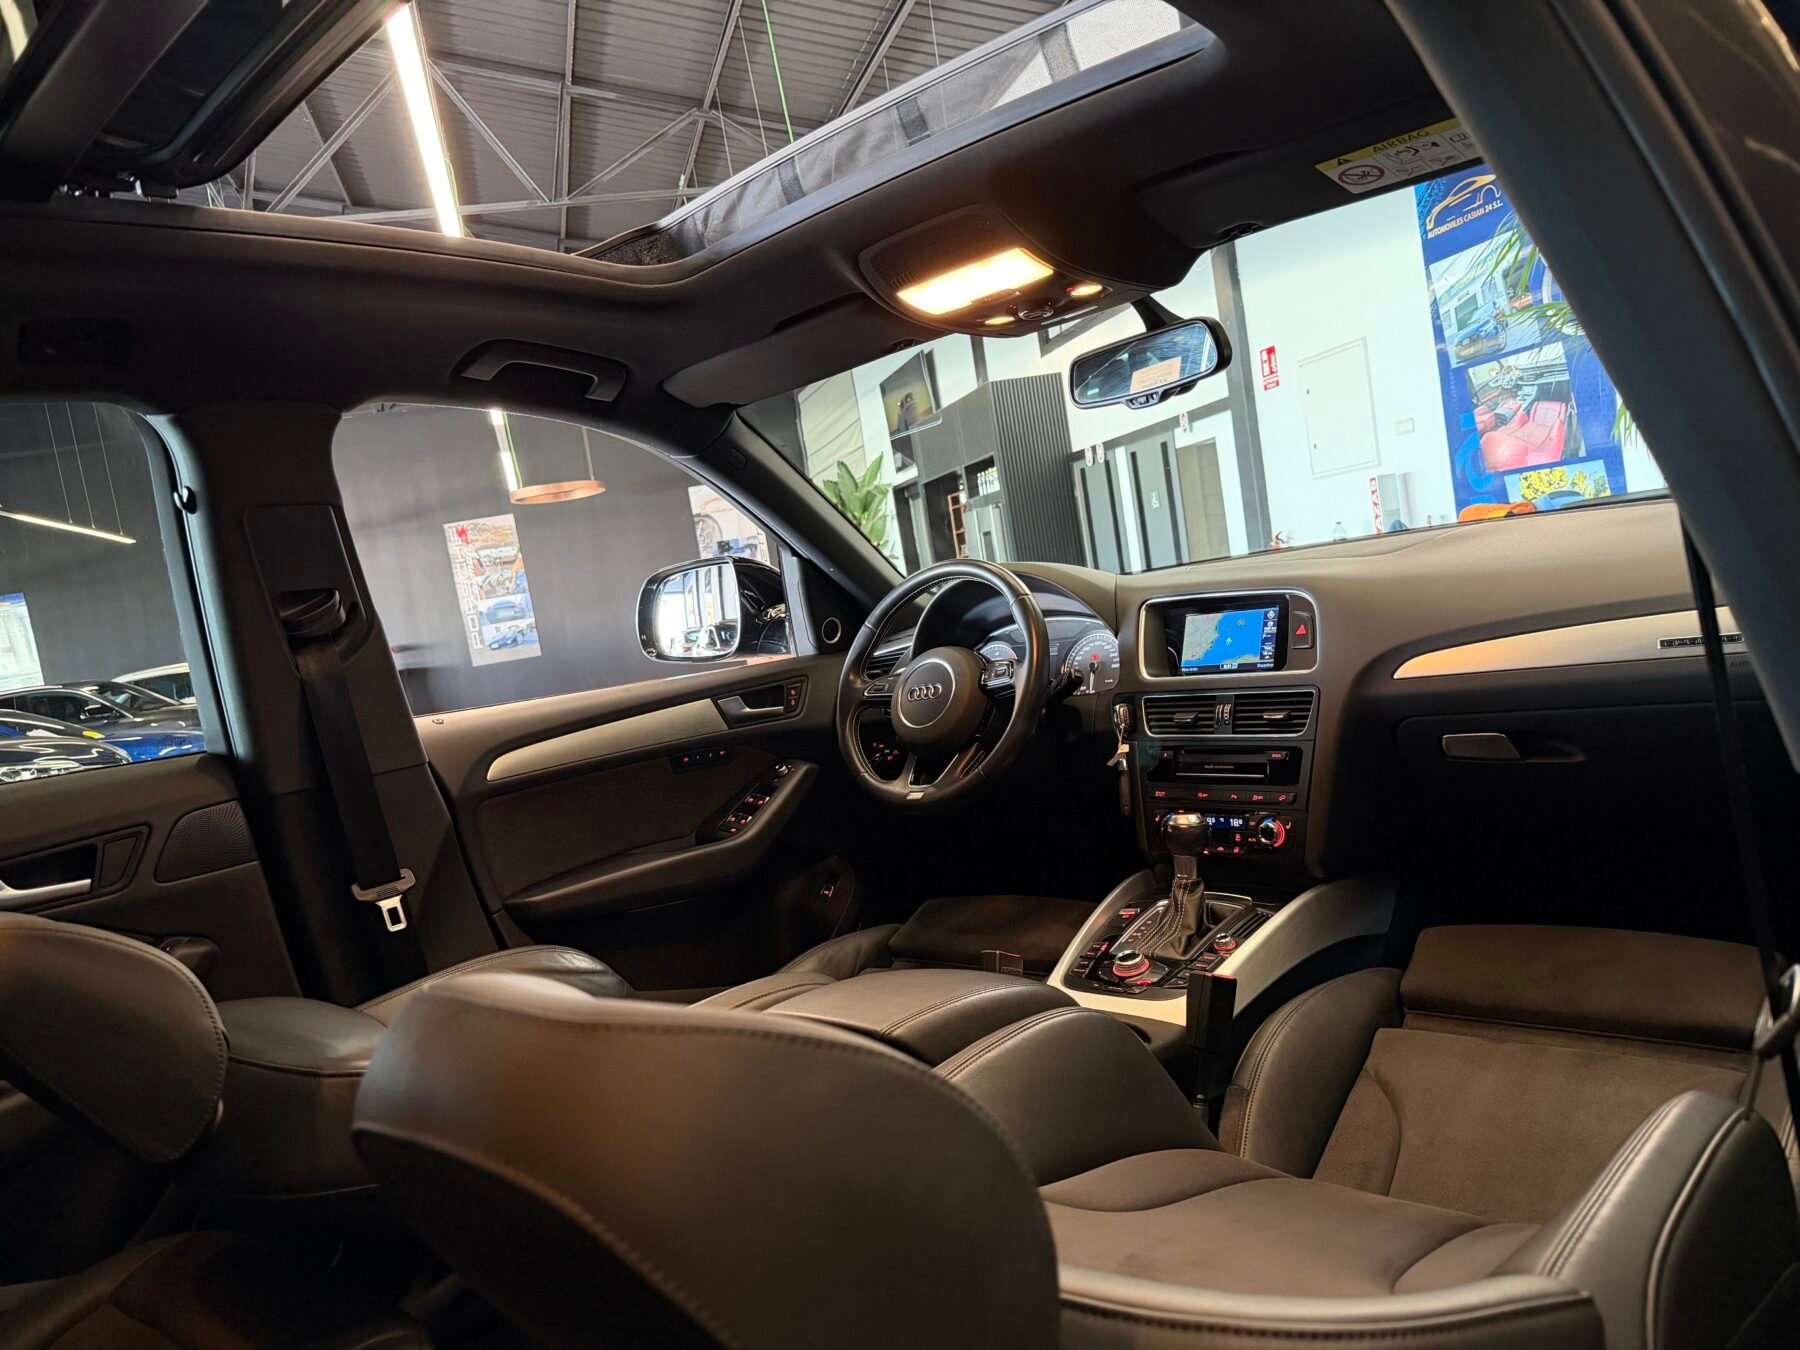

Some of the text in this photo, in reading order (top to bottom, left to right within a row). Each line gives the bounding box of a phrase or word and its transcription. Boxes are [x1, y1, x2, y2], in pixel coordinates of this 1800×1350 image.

[1372, 130, 1430, 154] AIRBAG
[1428, 217, 1464, 239] AUTOMOVILES
[447, 525, 484, 649] PORSCHE
